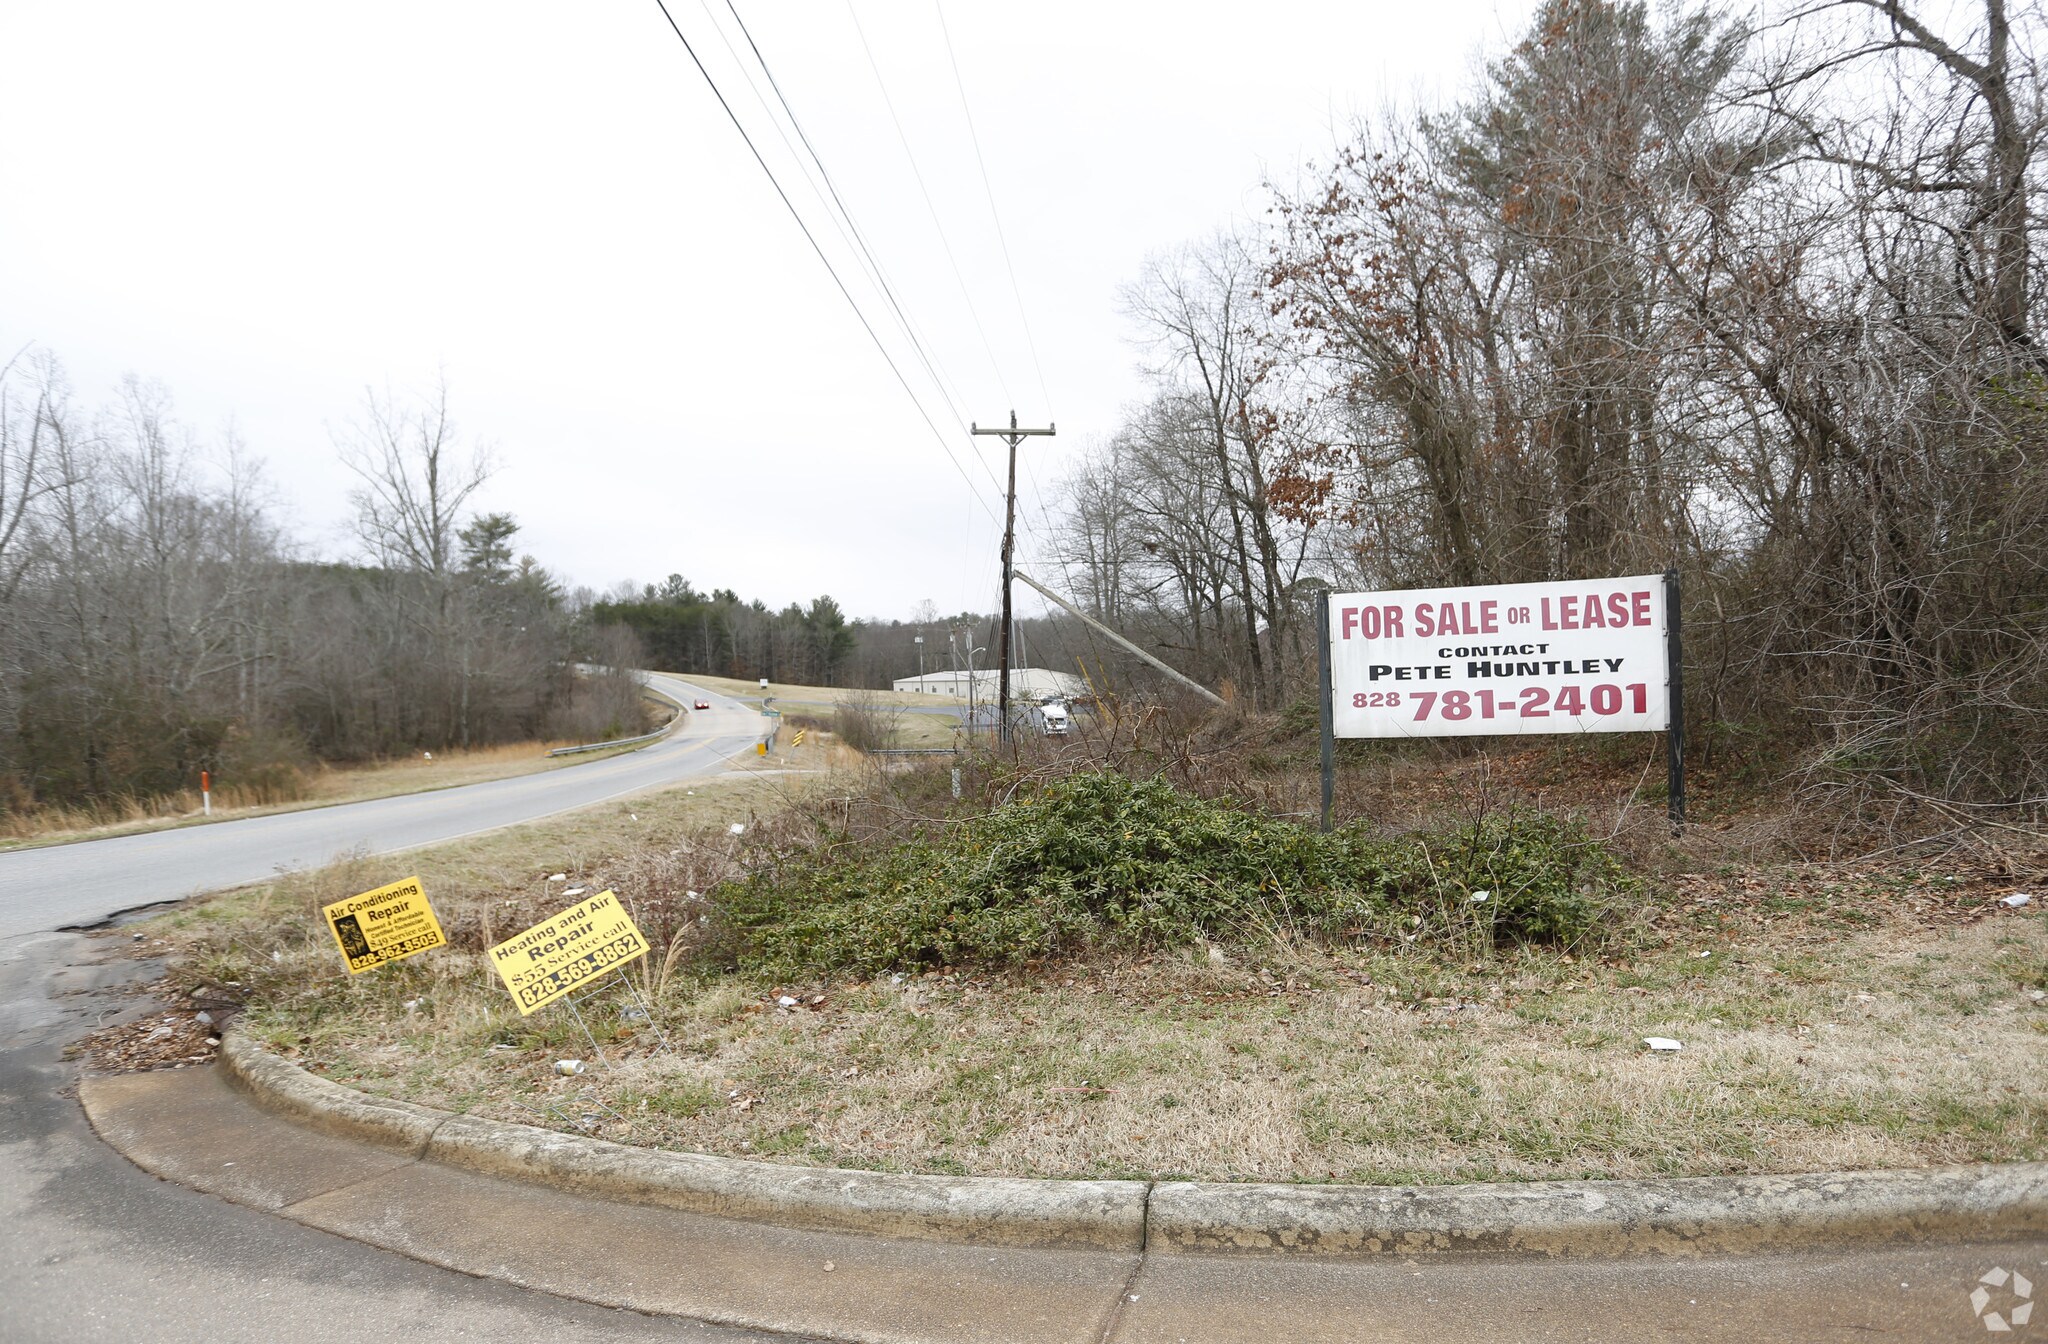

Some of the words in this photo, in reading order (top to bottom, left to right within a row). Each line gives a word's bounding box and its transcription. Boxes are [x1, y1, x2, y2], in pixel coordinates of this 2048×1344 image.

[1342, 606, 1404, 640] FOR
[1415, 601, 1499, 637] SALE
[1508, 607, 1530, 624] OR
[1541, 591, 1651, 631] LEASE
[1439, 644, 1549, 658] CONTACT
[1369, 664, 1451, 681] PETE
[1468, 659, 1624, 678] HUNTLEY
[1353, 692, 1400, 708] 828
[1410, 683, 1647, 721] 781-2401
[330, 908, 344, 919] Air
[348, 885, 417, 913] Conditioning
[368, 901, 409, 922] Repair
[370, 938, 388, 948] $49
[390, 928, 415, 941] Service
[418, 923, 431, 932] call
[495, 926, 556, 960] Heating
[559, 909, 585, 928] and
[590, 897, 609, 913] Air
[528, 921, 593, 961] Repair
[352, 932, 438, 968] 828-962-8505
[511, 964, 546, 986] $55
[548, 936, 600, 967] Service
[603, 921, 627, 939] call
[521, 935, 639, 1005] 828-569-8862
